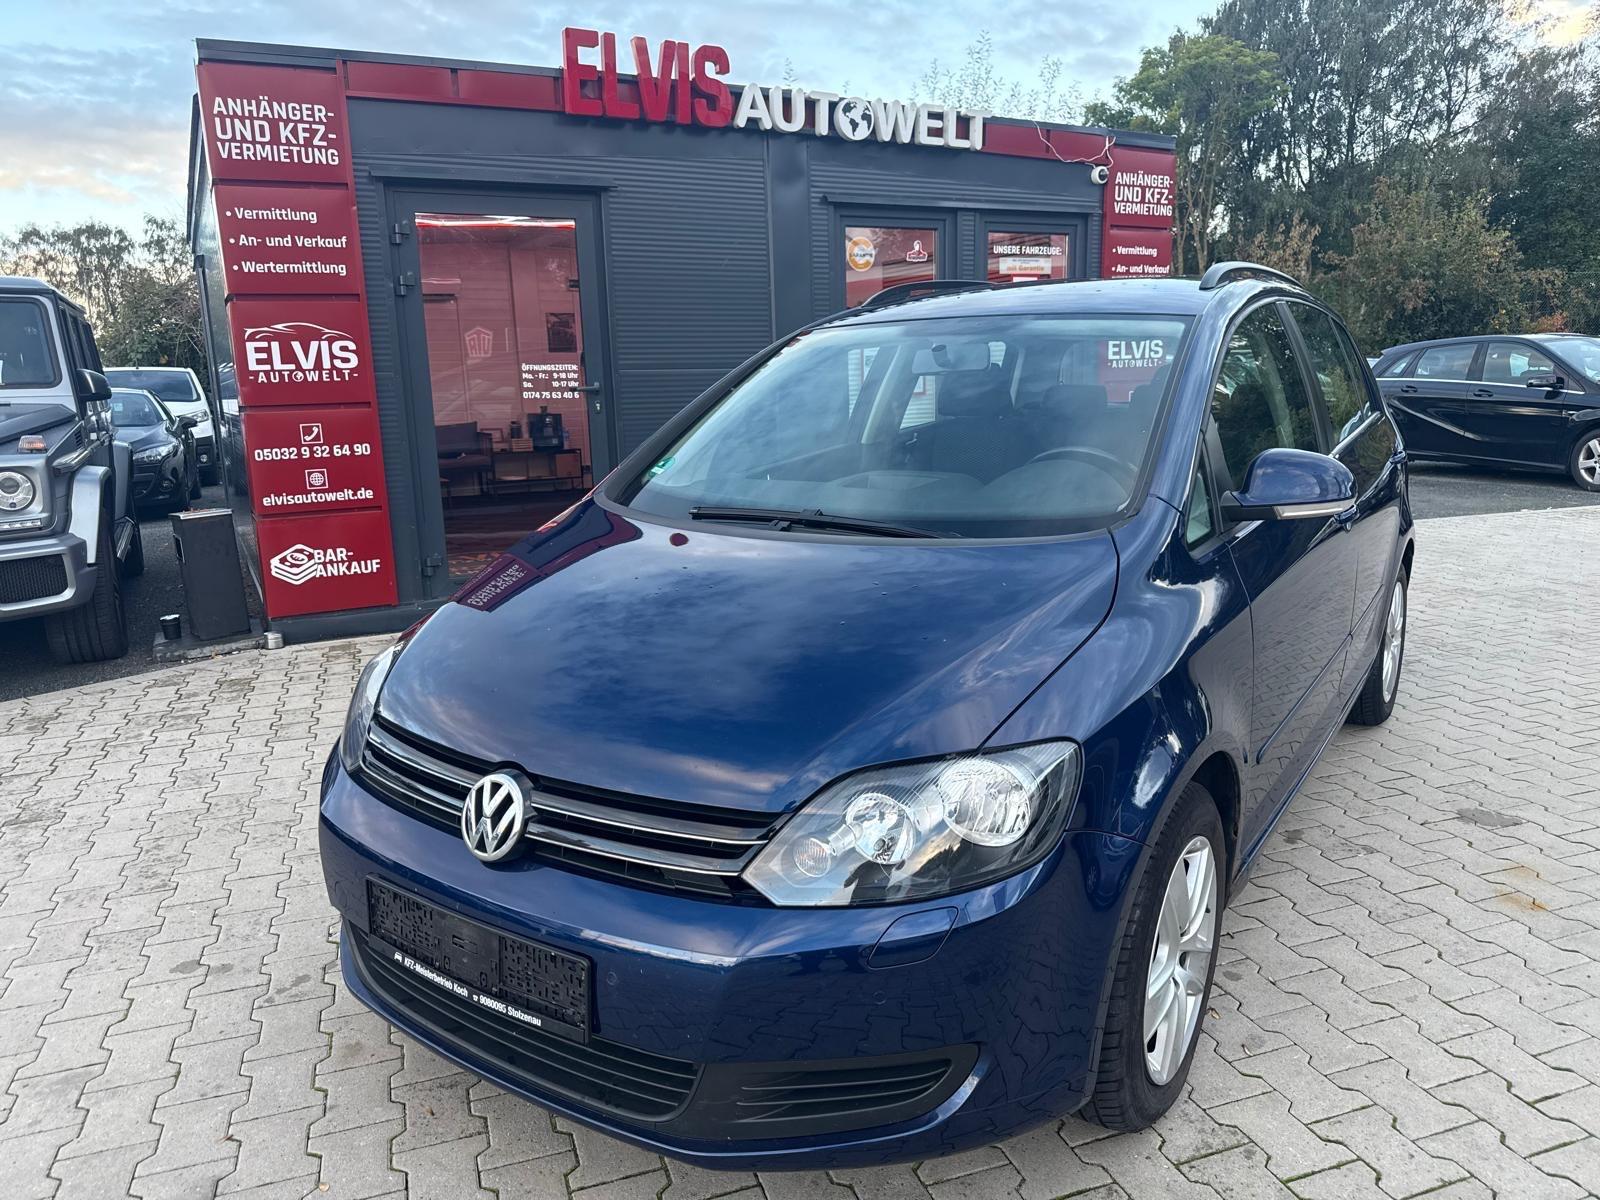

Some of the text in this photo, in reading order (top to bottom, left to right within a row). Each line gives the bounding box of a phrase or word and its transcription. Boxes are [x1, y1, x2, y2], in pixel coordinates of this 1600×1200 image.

[562, 27, 992, 151] ELVIS AUTOWELT
[213, 96, 335, 123] ANHÄNGER-
[215, 117, 337, 147] UND KFZ-
[217, 141, 339, 166] VERMIETUNG
[1115, 170, 1174, 188] ANHÄNGER-
[1114, 186, 1173, 204] UND KFZ-
[234, 207, 317, 224] Vermittlung
[1114, 202, 1173, 217] VERMIETUNG
[239, 234, 347, 248] An- und Verkauf
[993, 244, 1063, 256] UNSERE FAHRZEUGE:
[1116, 246, 1158, 258] Vermittlung
[241, 261, 347, 276] Wertermittlung
[1116, 264, 1170, 274] An- und Verkauf
[245, 340, 359, 371] ELVIS
[1107, 339, 1164, 360] ELVIS
[521, 363, 579, 371] ÖFFNUNGSZEITEN:
[522, 391, 540, 399] 0174
[541, 391, 551, 399] 75
[562, 391, 573, 399] 40
[254, 443, 371, 461] 05032 9 32 64 90
[262, 487, 374, 507] elvisautowelt.de
[313, 547, 354, 563] BAR-
[315, 559, 381, 578] ANKAUF
[404, 956, 453, 990] KFZ-Meisterbetrieb
[453, 982, 469, 997] Koch
[507, 1006, 542, 1027] Stolzenau
